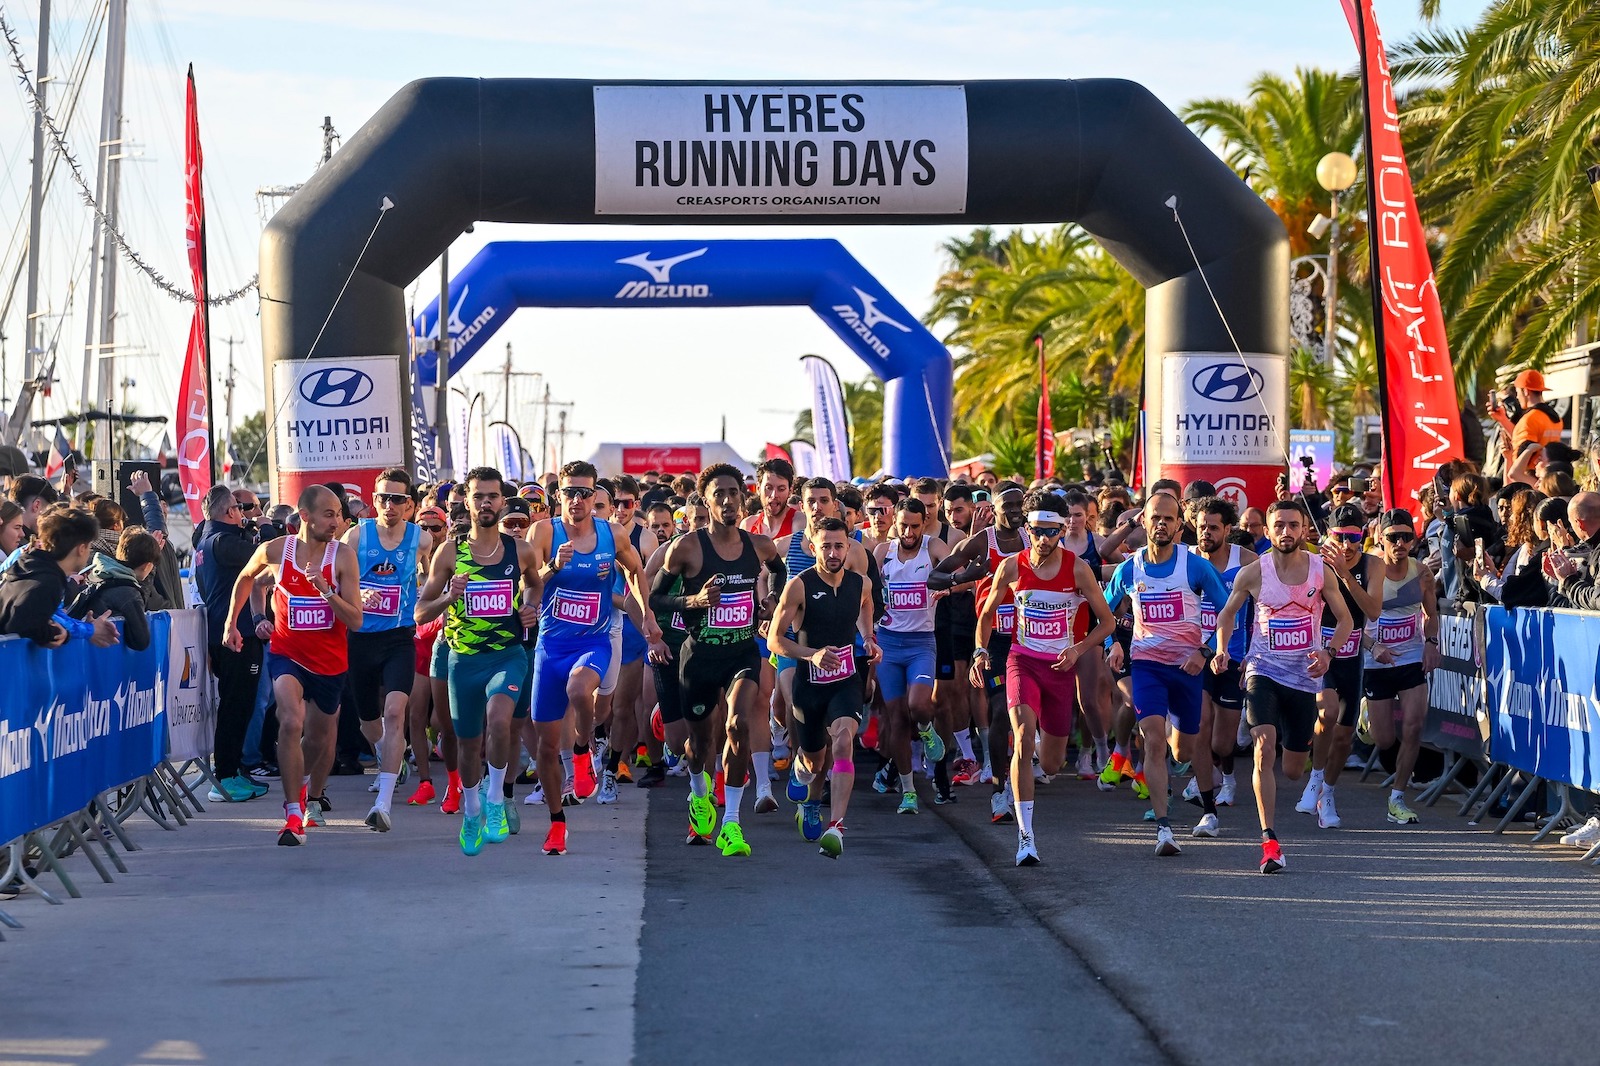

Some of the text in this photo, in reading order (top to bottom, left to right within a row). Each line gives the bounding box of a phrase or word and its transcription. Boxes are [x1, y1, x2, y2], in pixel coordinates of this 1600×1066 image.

[705, 94, 865, 133] HYERES
[635, 139, 936, 187] RUNNING DAYS
[676, 196, 881, 206] CREASPORTS ORGANISATION
[287, 416, 389, 437] HYUNDAI
[1176, 414, 1275, 431] HYUNDAI
[288, 437, 390, 453] BALDASSARI
[1175, 434, 1275, 447] BALDASSARI
[472, 594, 507, 611] 0048
[894, 592, 922, 606] 0046
[296, 609, 326, 625] 0012
[561, 602, 591, 619] 0061
[716, 606, 748, 623] 0056
[1148, 603, 1175, 619] 0113
[1030, 621, 1061, 636] 0023
[1382, 625, 1411, 640] 0040
[1275, 630, 1307, 647] 0060
